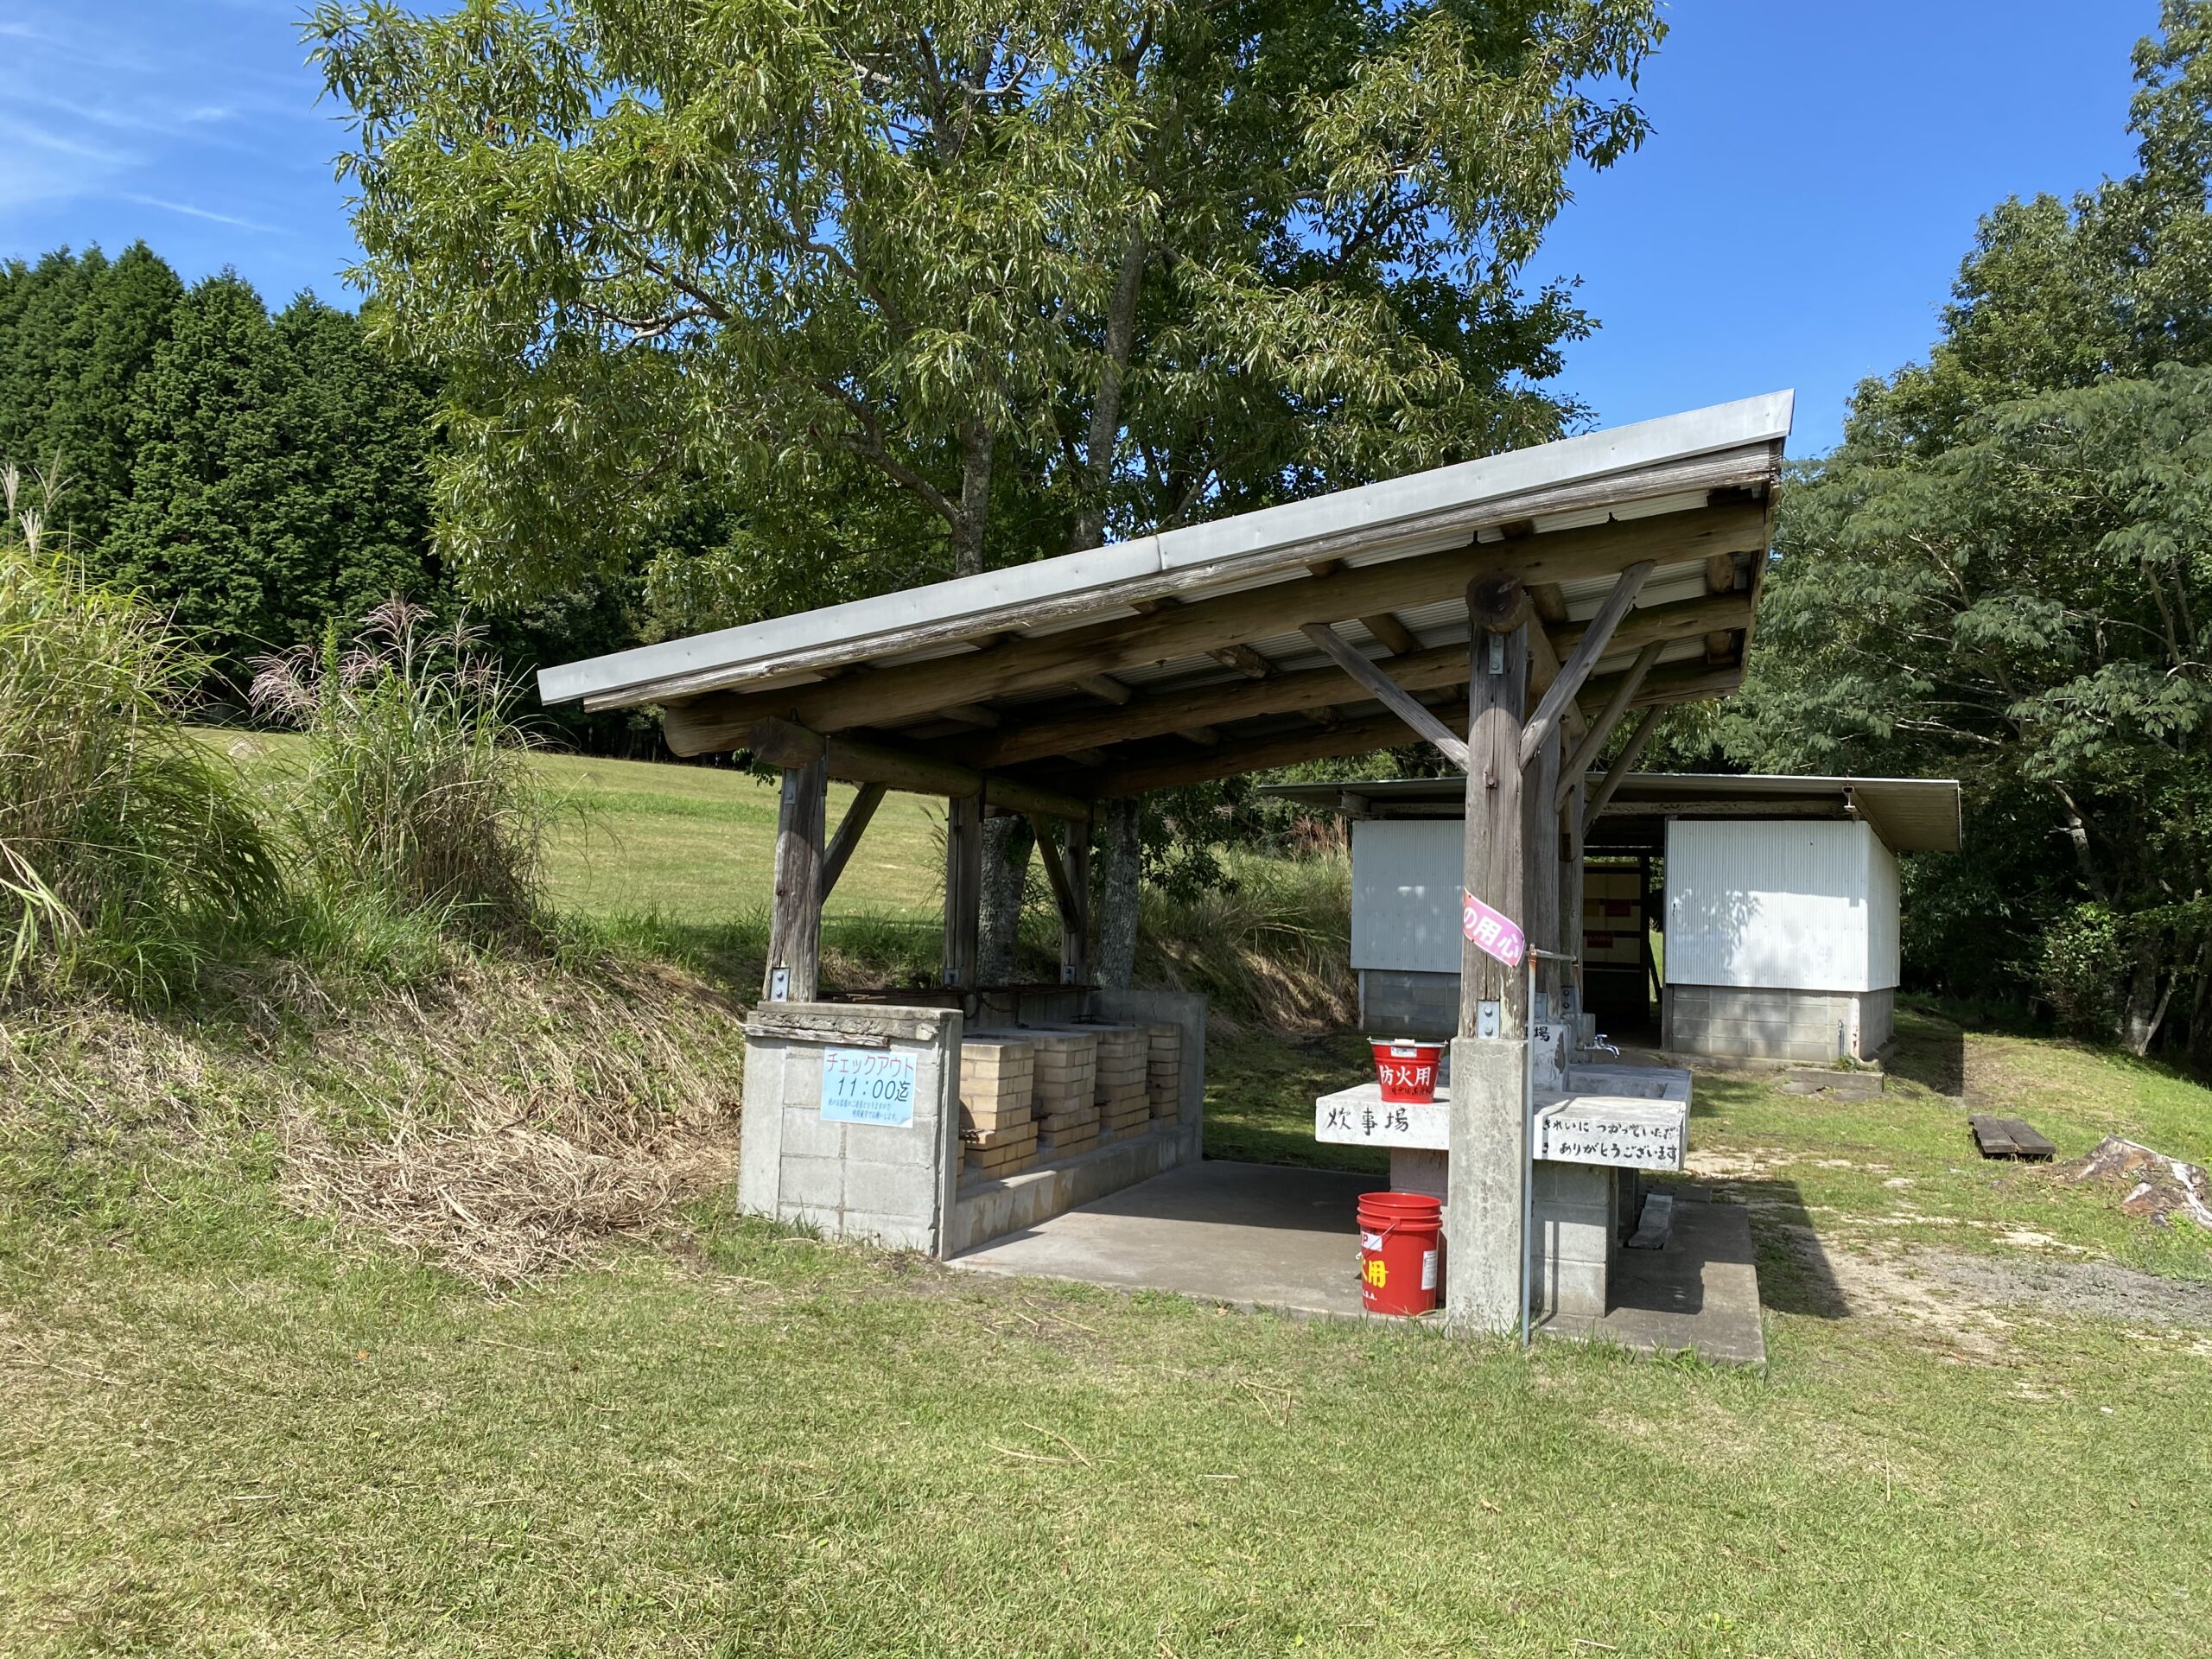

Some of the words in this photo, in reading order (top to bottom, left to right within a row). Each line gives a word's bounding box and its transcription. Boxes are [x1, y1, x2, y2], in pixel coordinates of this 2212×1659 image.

[1464, 907, 1519, 958] の用心
[826, 1052, 913, 1078] チェックアウト
[1379, 1065, 1431, 1087] 防火用
[1327, 1107, 1409, 1136] 炊事場
[1560, 1141, 1677, 1163] ありがとうございます
